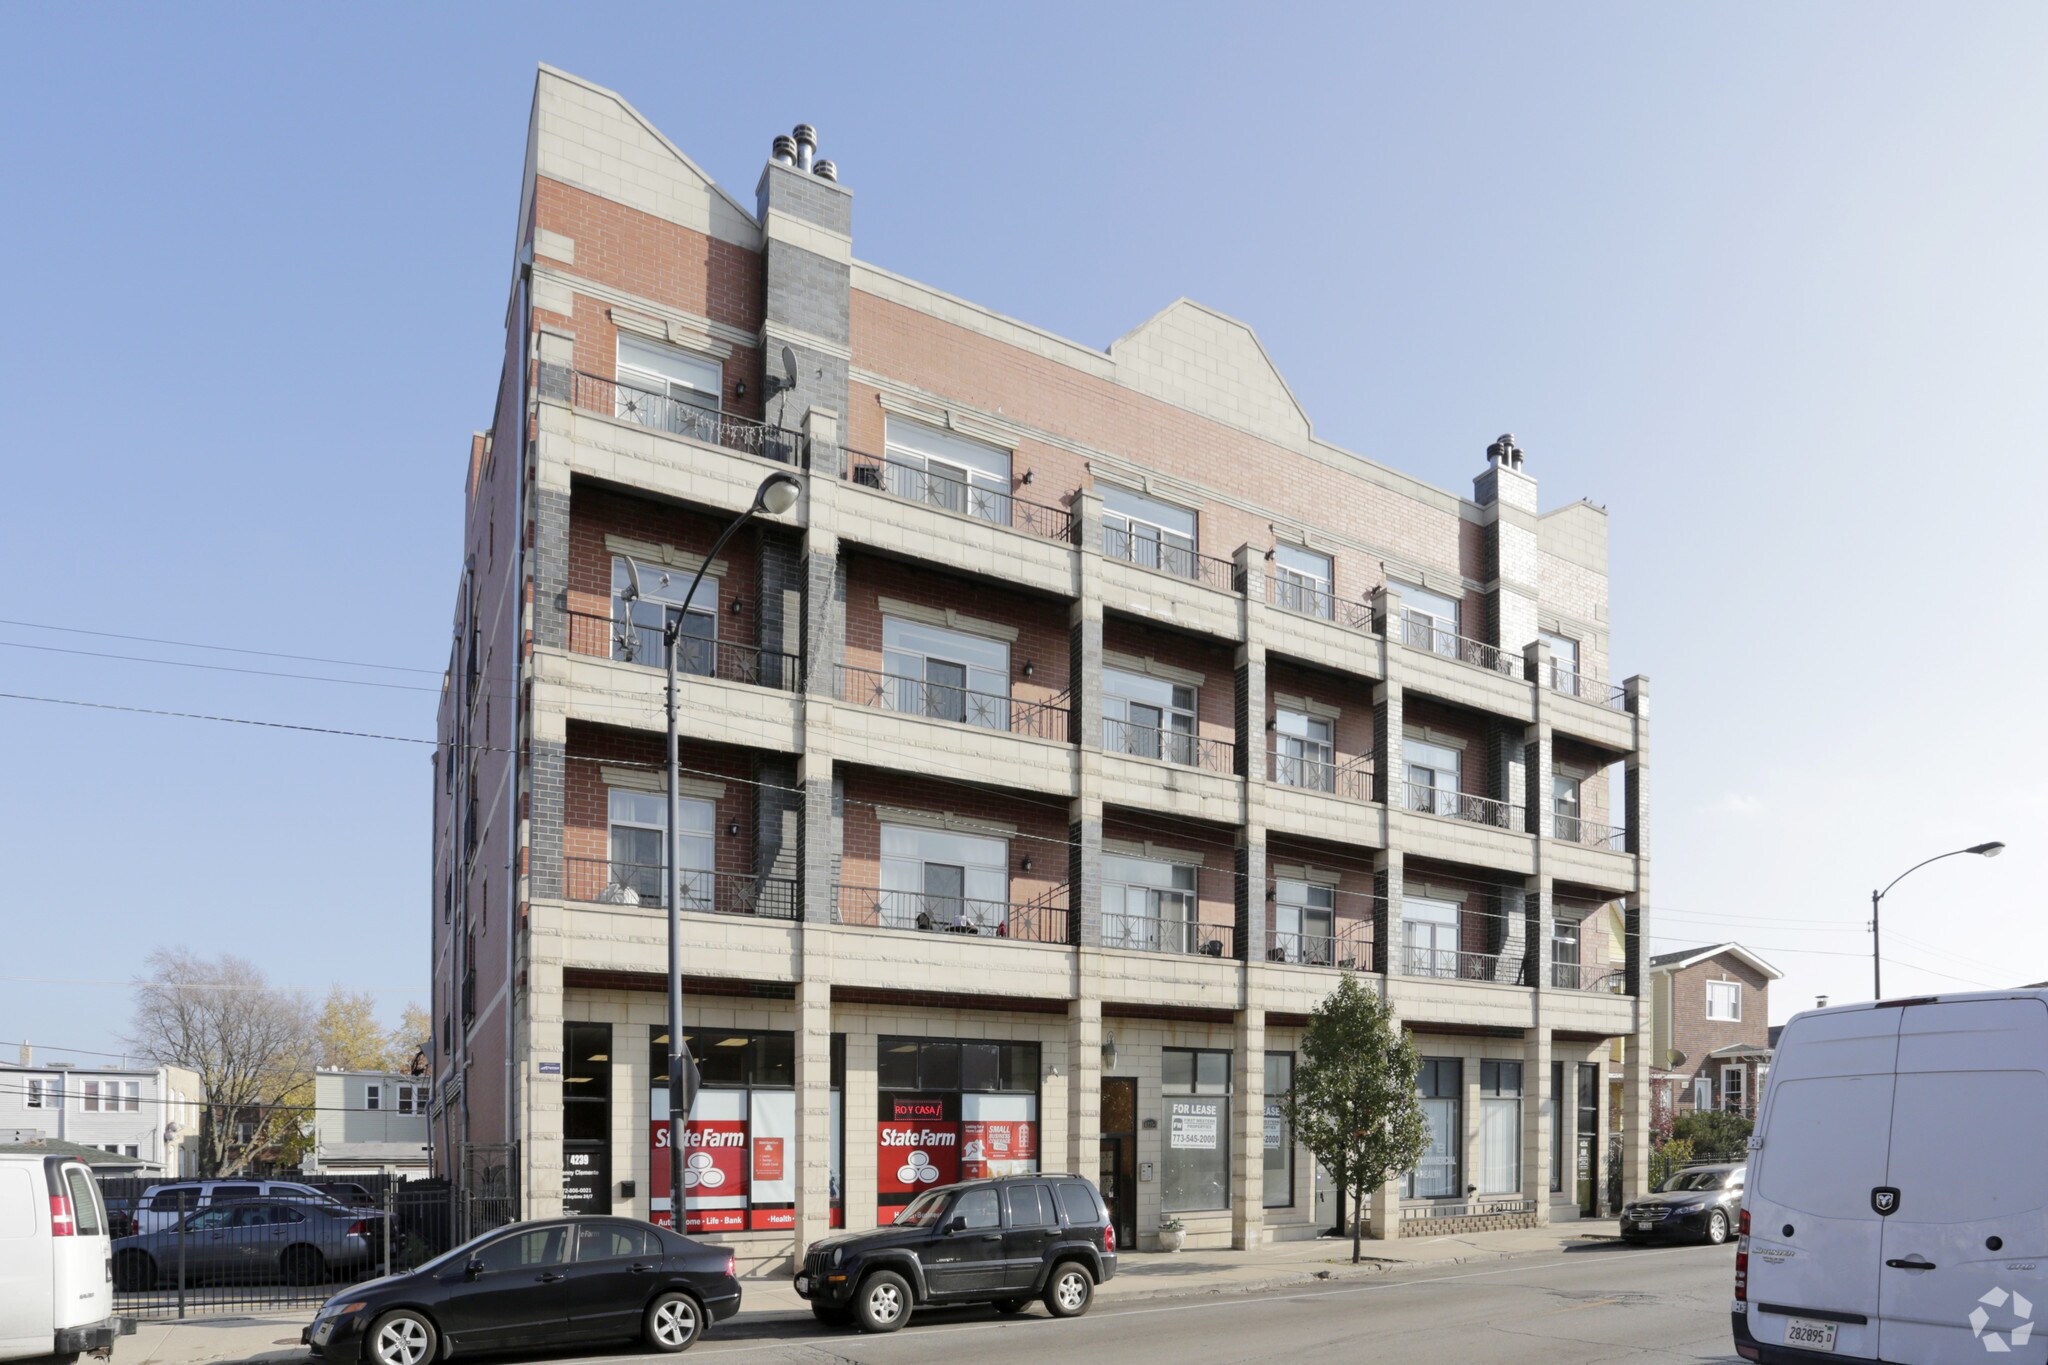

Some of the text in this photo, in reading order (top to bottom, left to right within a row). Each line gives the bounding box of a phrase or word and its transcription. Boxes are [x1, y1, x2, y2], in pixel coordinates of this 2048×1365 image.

[915, 1106, 935, 1115] CASA
[1173, 1104, 1217, 1115] FOR LEASE
[1263, 1107, 1280, 1116] EASE
[1173, 1134, 1215, 1144] 773-545-2000
[570, 1154, 589, 1165] 4239
[706, 1217, 719, 1225] Life
[724, 1216, 742, 1224] Bank
[1789, 1326, 1825, 1343] 282895
